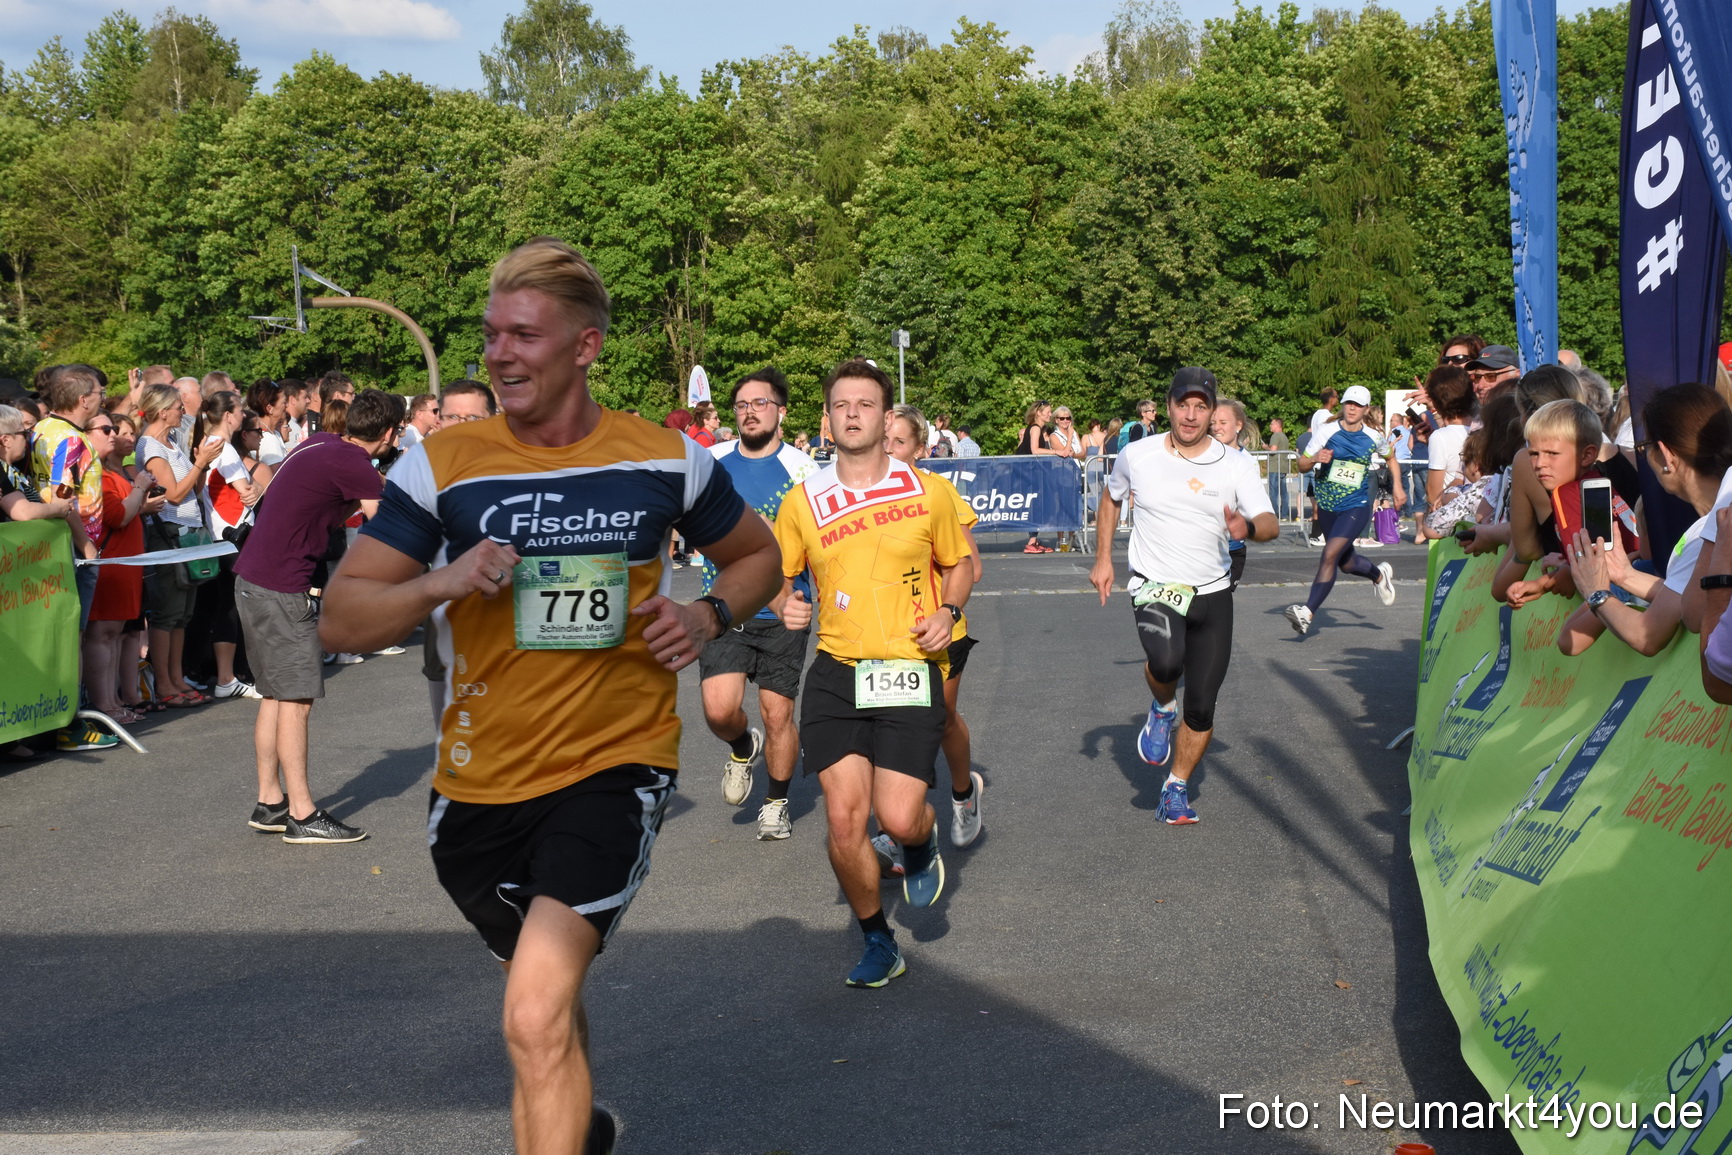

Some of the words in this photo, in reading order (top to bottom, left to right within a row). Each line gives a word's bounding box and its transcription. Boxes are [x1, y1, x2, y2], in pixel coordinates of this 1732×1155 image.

[1337, 469, 1355, 479] 244
[961, 488, 1038, 511] scher
[510, 508, 647, 536] Fischer
[820, 516, 868, 549] MAX
[872, 503, 929, 526] BÖGL
[525, 531, 637, 548] AUTOMOBILE
[540, 588, 610, 622] 778
[540, 624, 584, 633] Schindler
[587, 623, 614, 632] Martin
[865, 672, 920, 691] 1549
[1644, 689, 1728, 749] Gesunde
[1622, 762, 1693, 832] laufen
